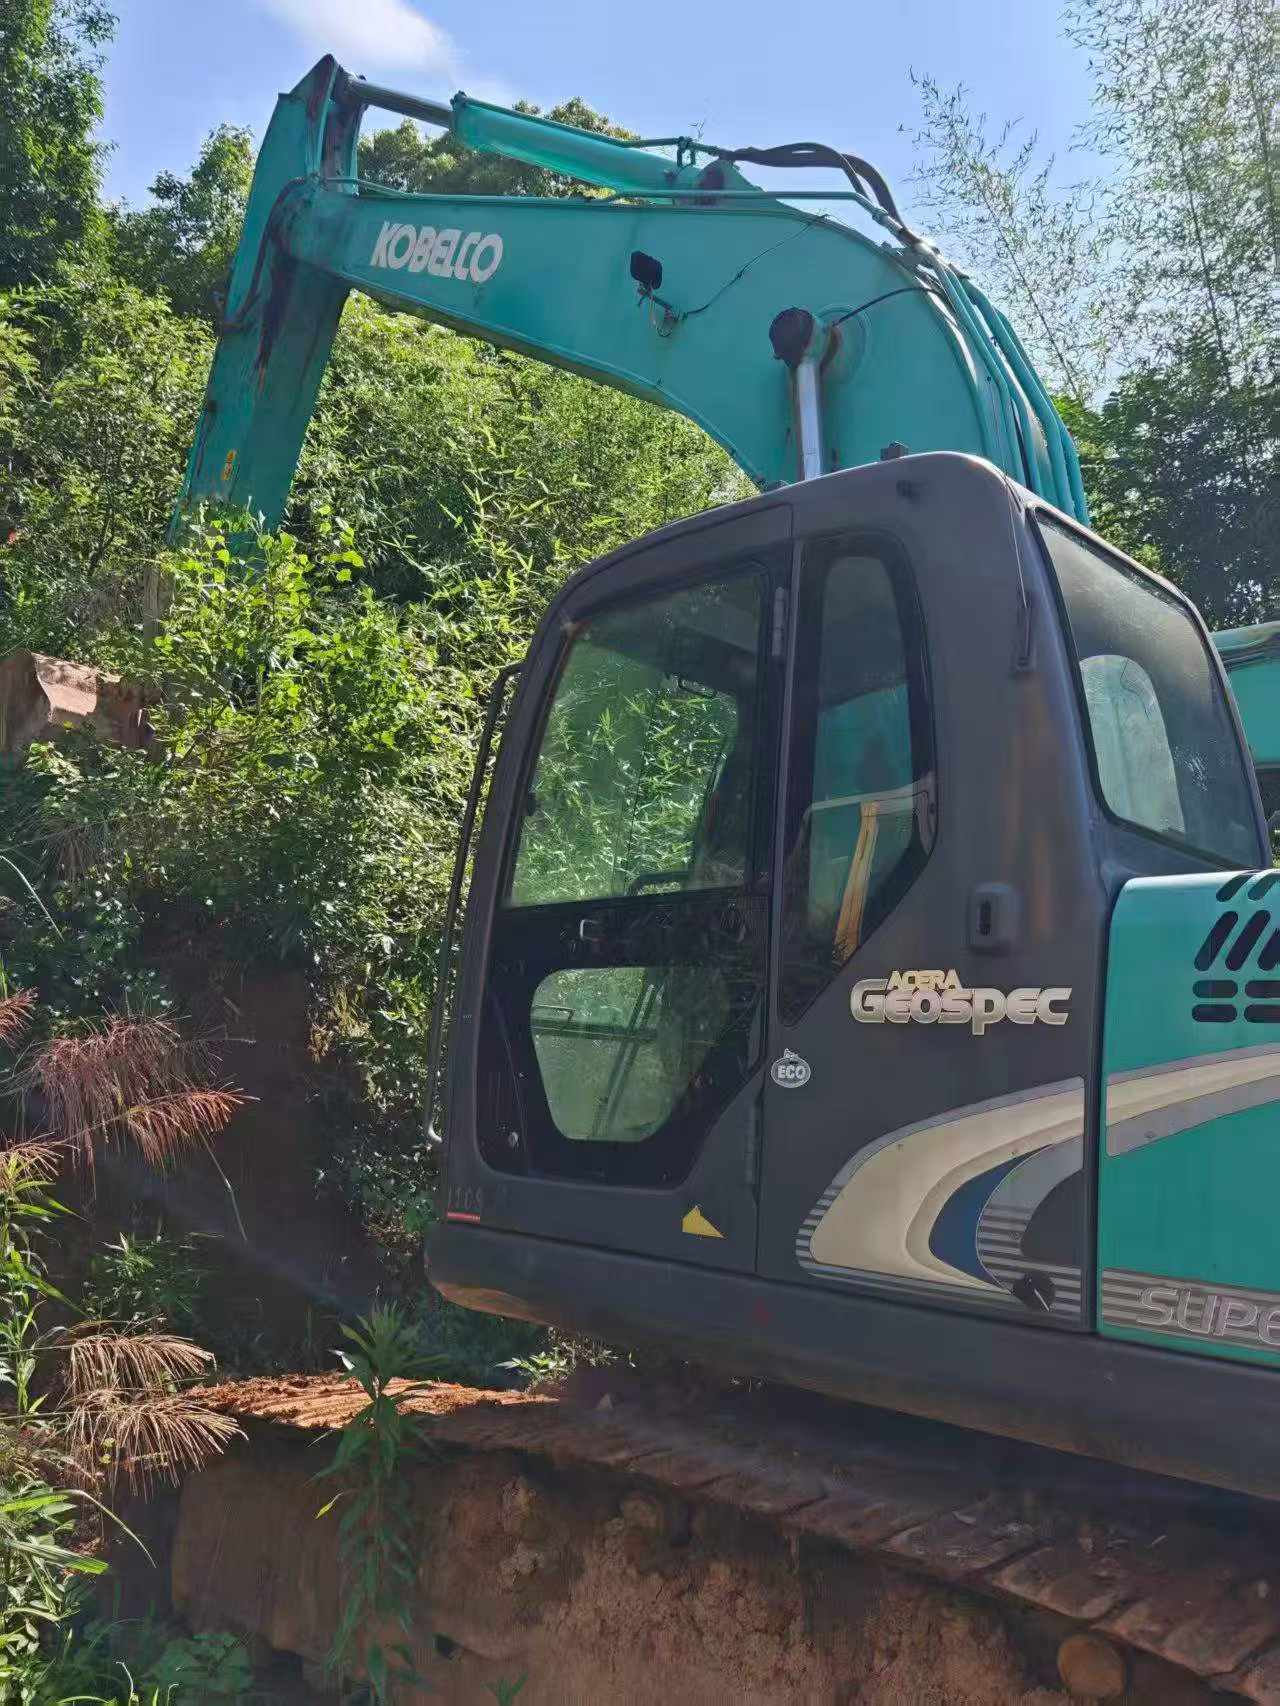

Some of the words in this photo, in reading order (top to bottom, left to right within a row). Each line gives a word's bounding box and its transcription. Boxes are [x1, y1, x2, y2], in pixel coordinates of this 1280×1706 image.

[370, 221, 504, 283] KOBELCO
[887, 969, 963, 991] ACERA
[777, 1065, 807, 1079] ECO
